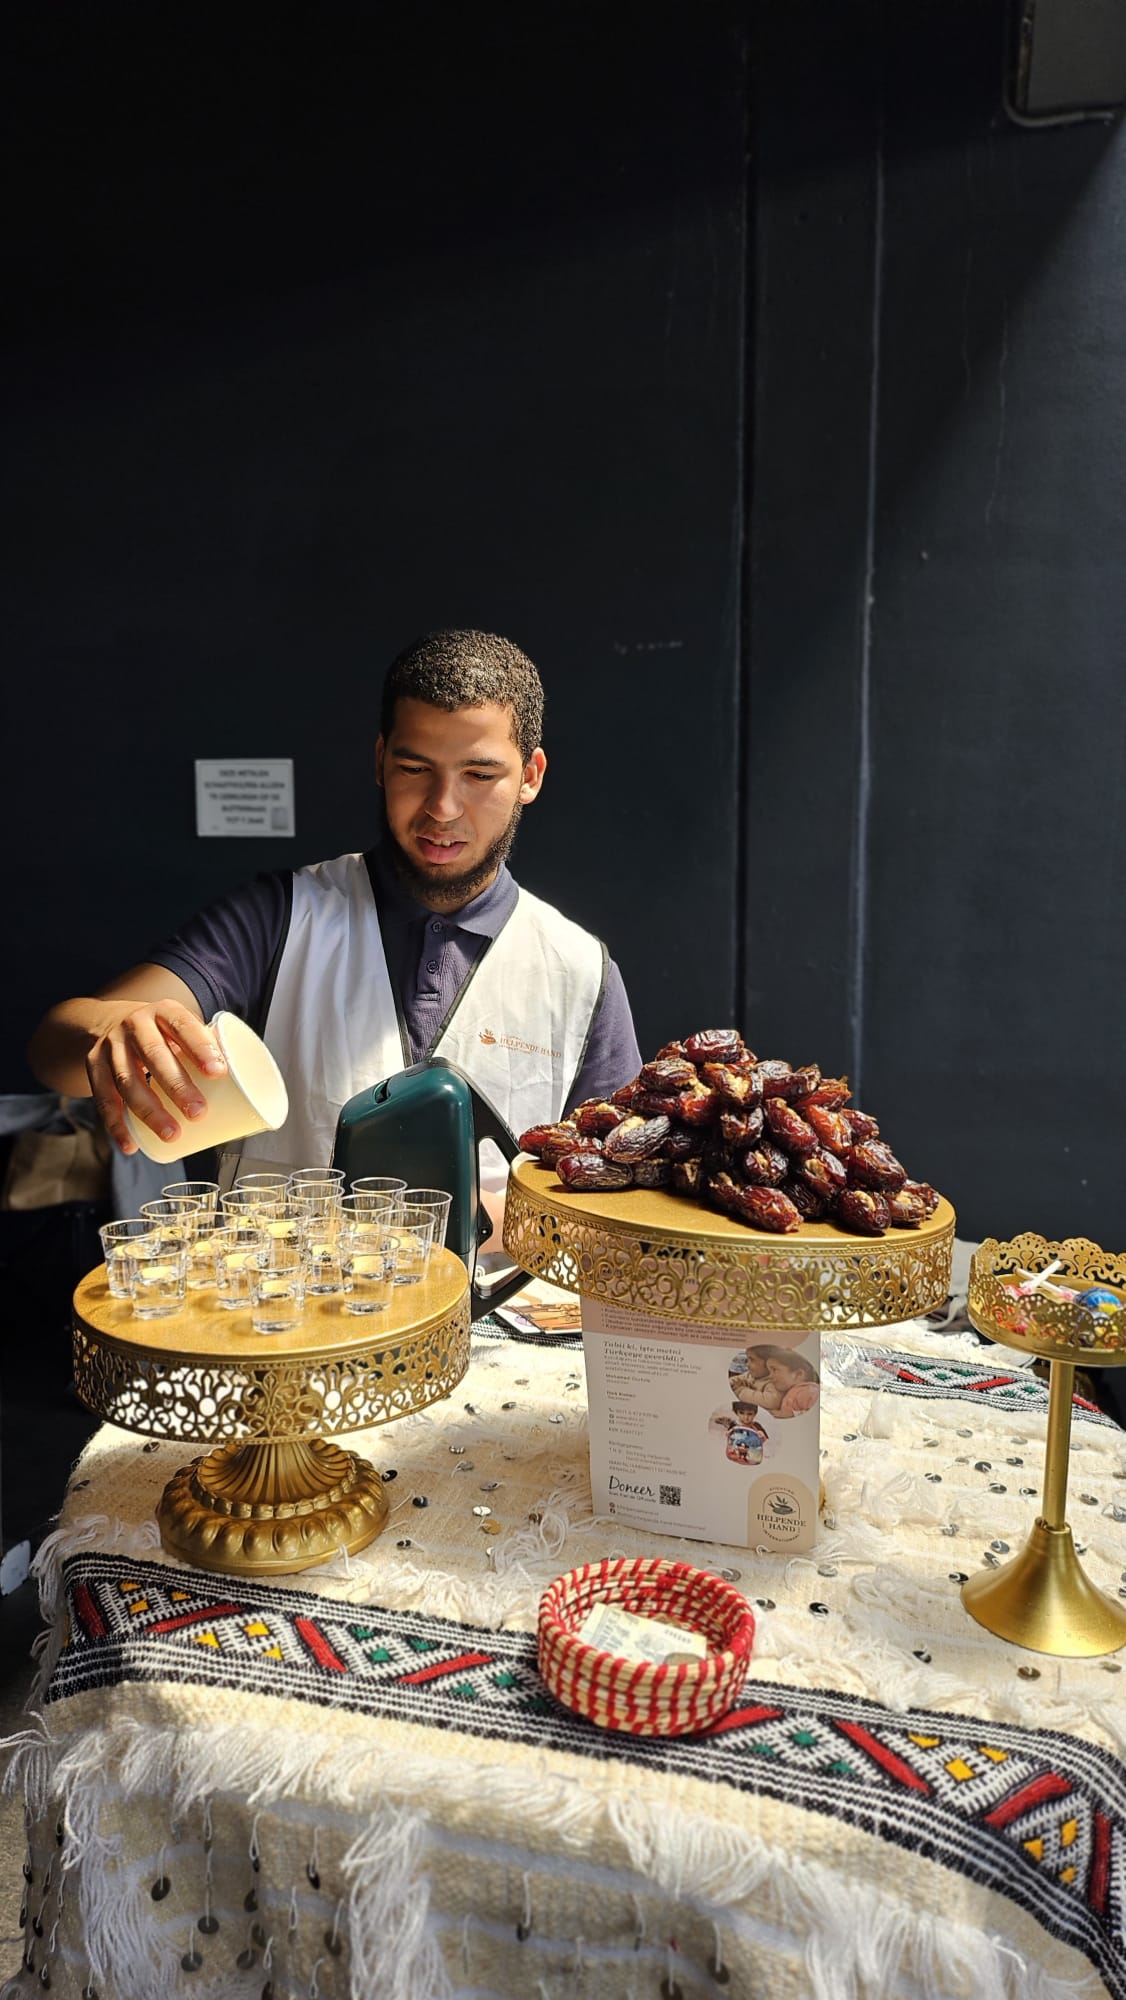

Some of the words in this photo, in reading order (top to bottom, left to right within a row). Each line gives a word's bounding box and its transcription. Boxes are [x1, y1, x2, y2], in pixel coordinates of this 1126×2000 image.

[609, 1475, 655, 1497] Doneer
[757, 1513, 807, 1527] HELPENDE
[769, 1523, 796, 1532] HAND
